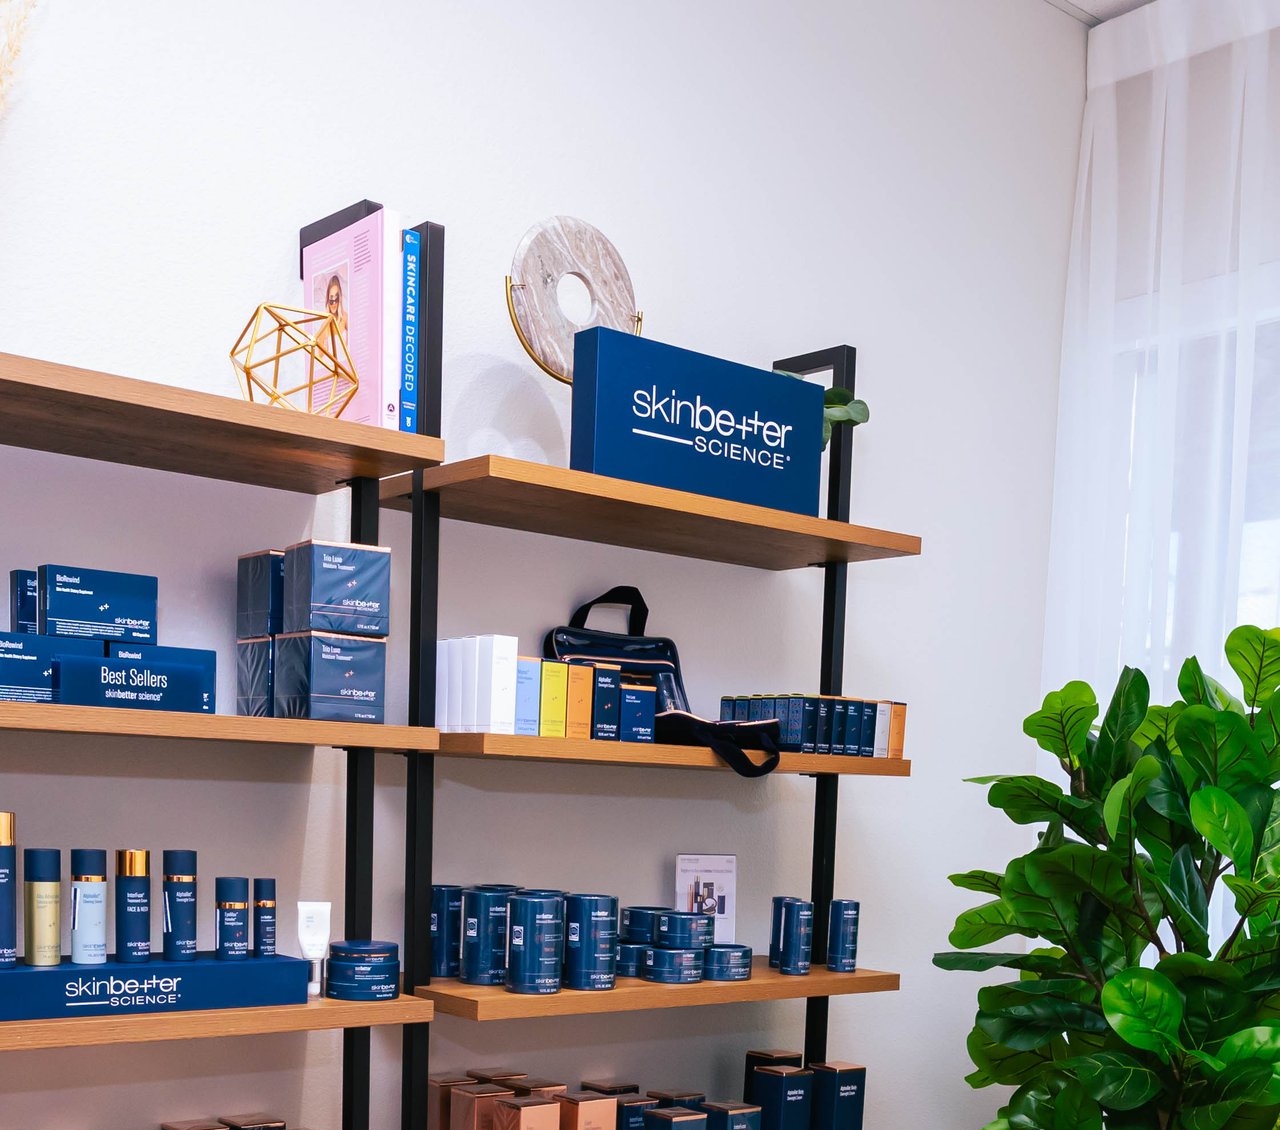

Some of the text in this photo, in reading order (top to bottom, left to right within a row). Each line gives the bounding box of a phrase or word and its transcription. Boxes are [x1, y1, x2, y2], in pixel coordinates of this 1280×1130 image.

[405, 254, 417, 392] SKINCARE DECODED
[632, 385, 793, 448] skinbetter
[694, 436, 786, 470] SCIENCE
[101, 667, 168, 688] Best Sellers
[106, 689, 161, 701] skinbetter science
[65, 975, 182, 997] skinbetter
[110, 994, 177, 1007] SCIENCE
